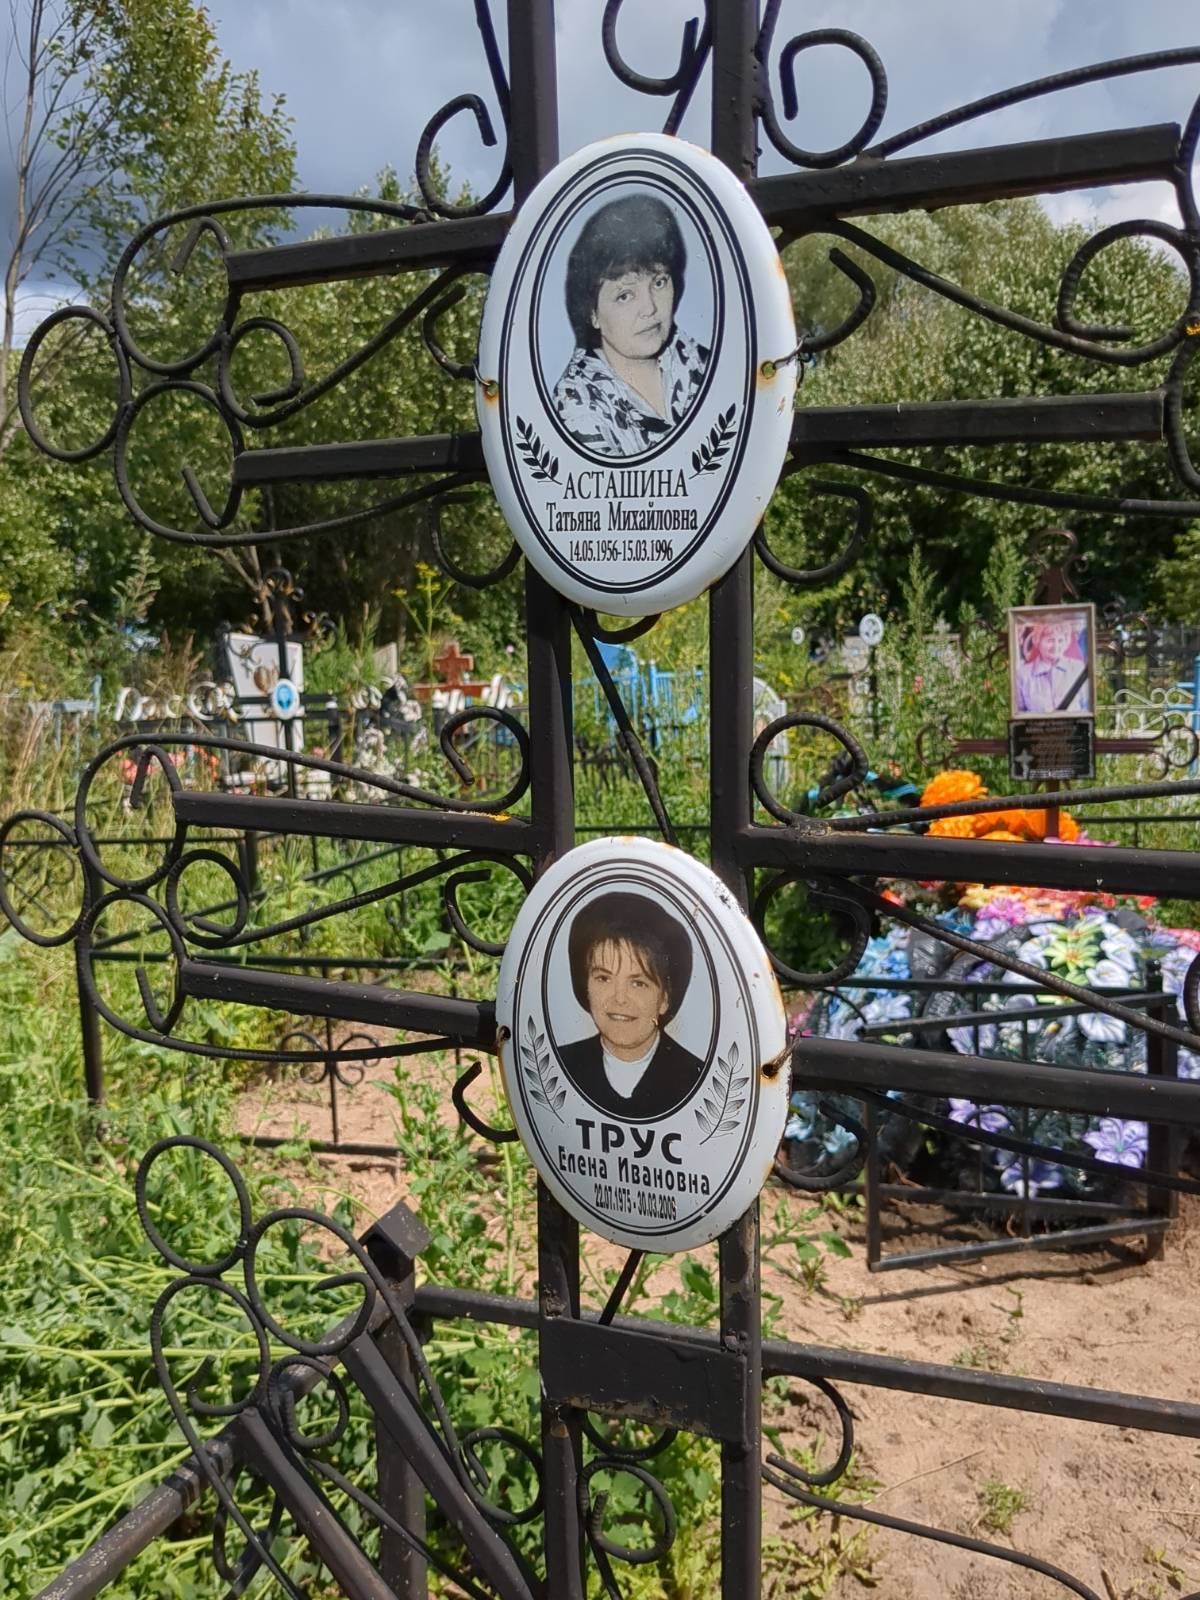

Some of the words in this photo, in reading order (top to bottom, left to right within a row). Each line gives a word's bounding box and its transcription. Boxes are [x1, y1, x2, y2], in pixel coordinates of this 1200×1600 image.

[563, 469, 688, 499] АСТАШИНА
[546, 502, 601, 532] Татьяна
[608, 501, 698, 531] Михайловна
[569, 539, 673, 561] 14.05.1956-15.03.1996
[576, 1118, 682, 1165] ТРУС
[559, 1145, 608, 1180] Елена
[618, 1157, 710, 1196] Ивановна
